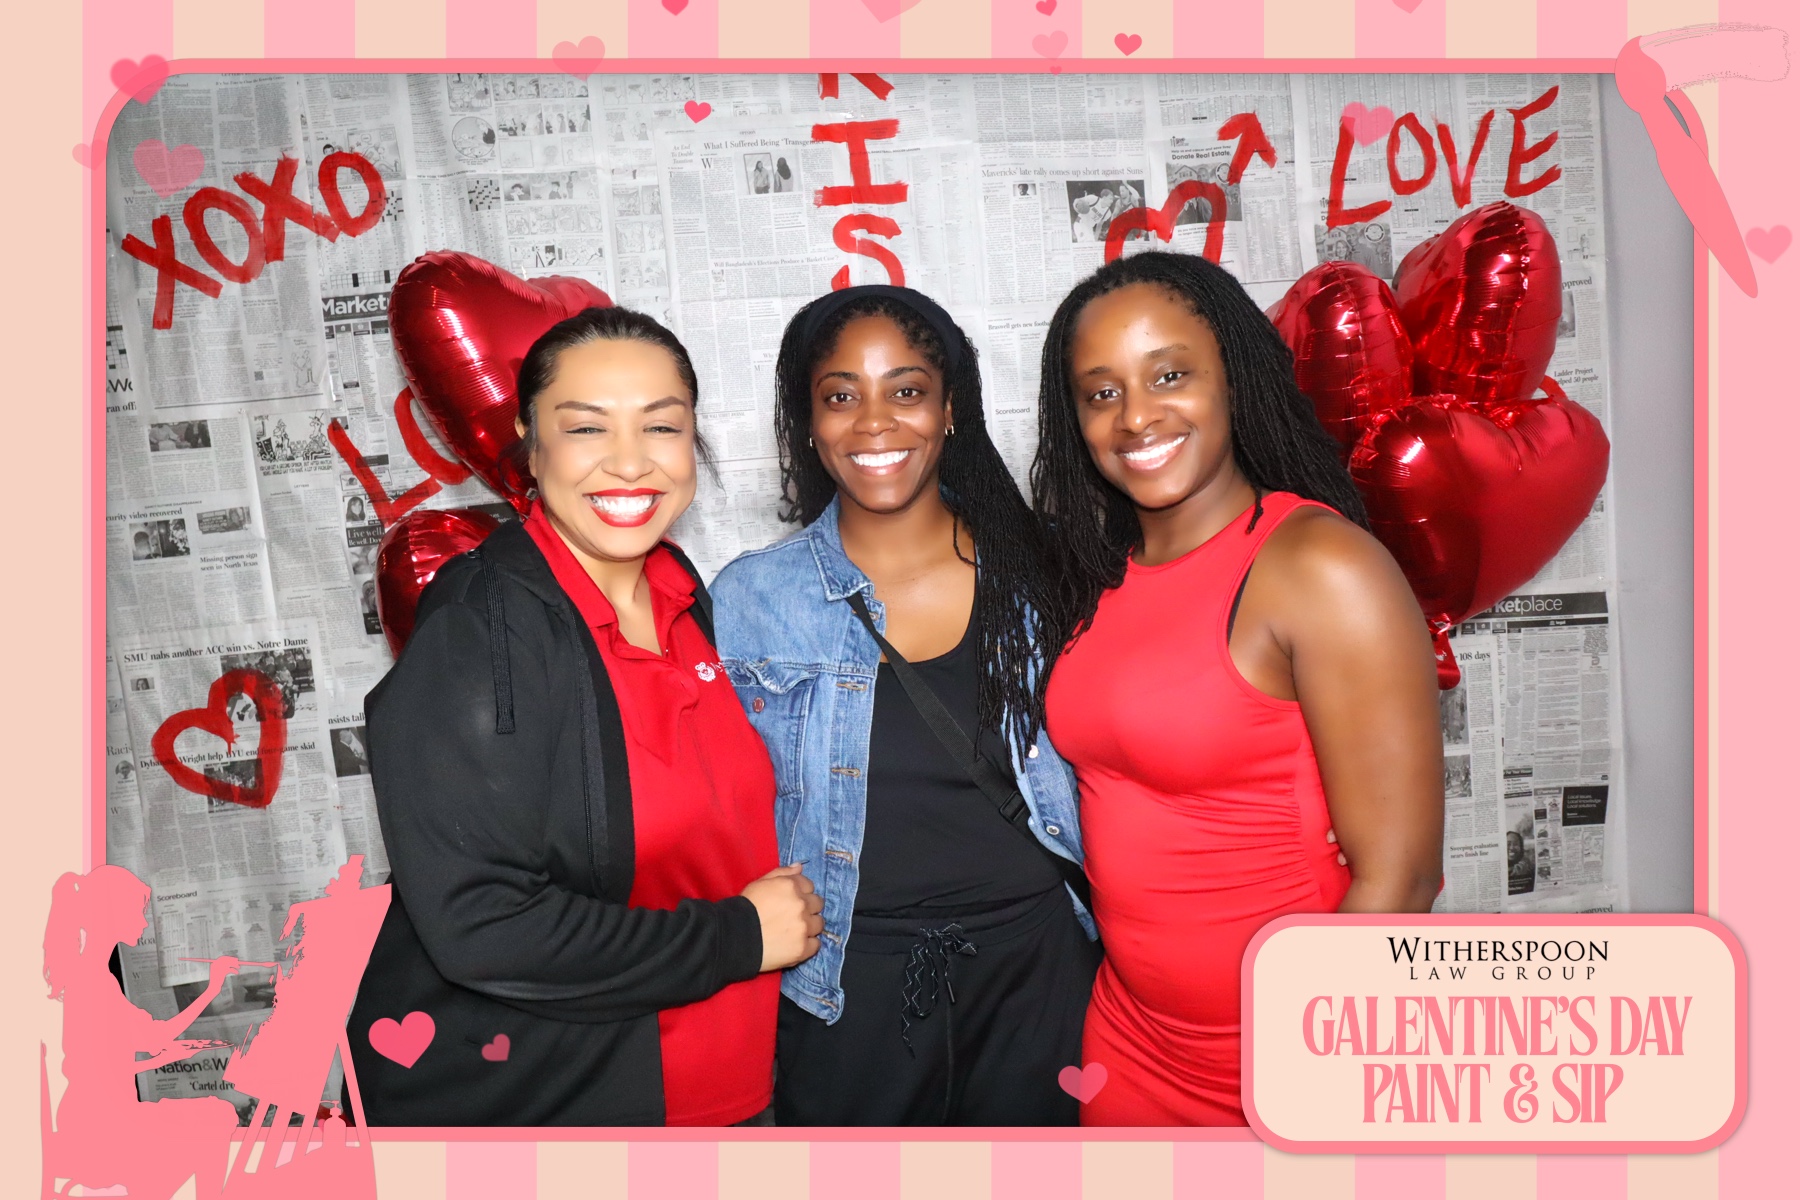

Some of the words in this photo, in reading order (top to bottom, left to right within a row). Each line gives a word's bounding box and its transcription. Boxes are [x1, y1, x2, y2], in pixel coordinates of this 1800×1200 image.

[704, 141, 723, 150] What
[730, 138, 759, 148] Suffered
[760, 138, 780, 148] Being
[1326, 84, 1562, 232] LOVE
[1019, 166, 1032, 176] late
[1033, 166, 1048, 178] rally
[1071, 169, 1082, 178] up
[1084, 166, 1100, 176] short
[1101, 166, 1125, 178] against
[1126, 166, 1143, 175] Suns
[120, 151, 386, 330] XOXO
[321, 294, 390, 316] Market
[1554, 368, 1574, 378] Ladder
[1575, 368, 1594, 377] Project
[1582, 374, 1599, 384] people
[995, 406, 1030, 416] Scoreboard
[129, 510, 148, 520] video
[149, 508, 182, 518] recovered
[347, 528, 365, 539] Live
[200, 556, 224, 564] Missing
[225, 554, 245, 562] person
[245, 552, 258, 561] sign
[200, 564, 214, 572] seen
[224, 562, 242, 570] North
[243, 560, 258, 568] Texas
[1484, 596, 1563, 616] ketplace
[124, 652, 148, 664] SMU
[150, 650, 170, 661] nabs
[172, 648, 203, 658] another
[204, 646, 224, 656] ACC
[226, 643, 242, 653] win
[257, 640, 282, 650] Notre
[283, 638, 308, 647] Dame
[1460, 651, 1472, 662] 108
[1474, 650, 1491, 662] days
[328, 714, 350, 725] nsists
[178, 753, 206, 764] Wright
[207, 751, 224, 762] help
[226, 749, 244, 758] BYU
[245, 747, 260, 756] end
[300, 741, 316, 751] skid
[1474, 842, 1499, 850] evaluation
[156, 890, 198, 902] Scoreboard
